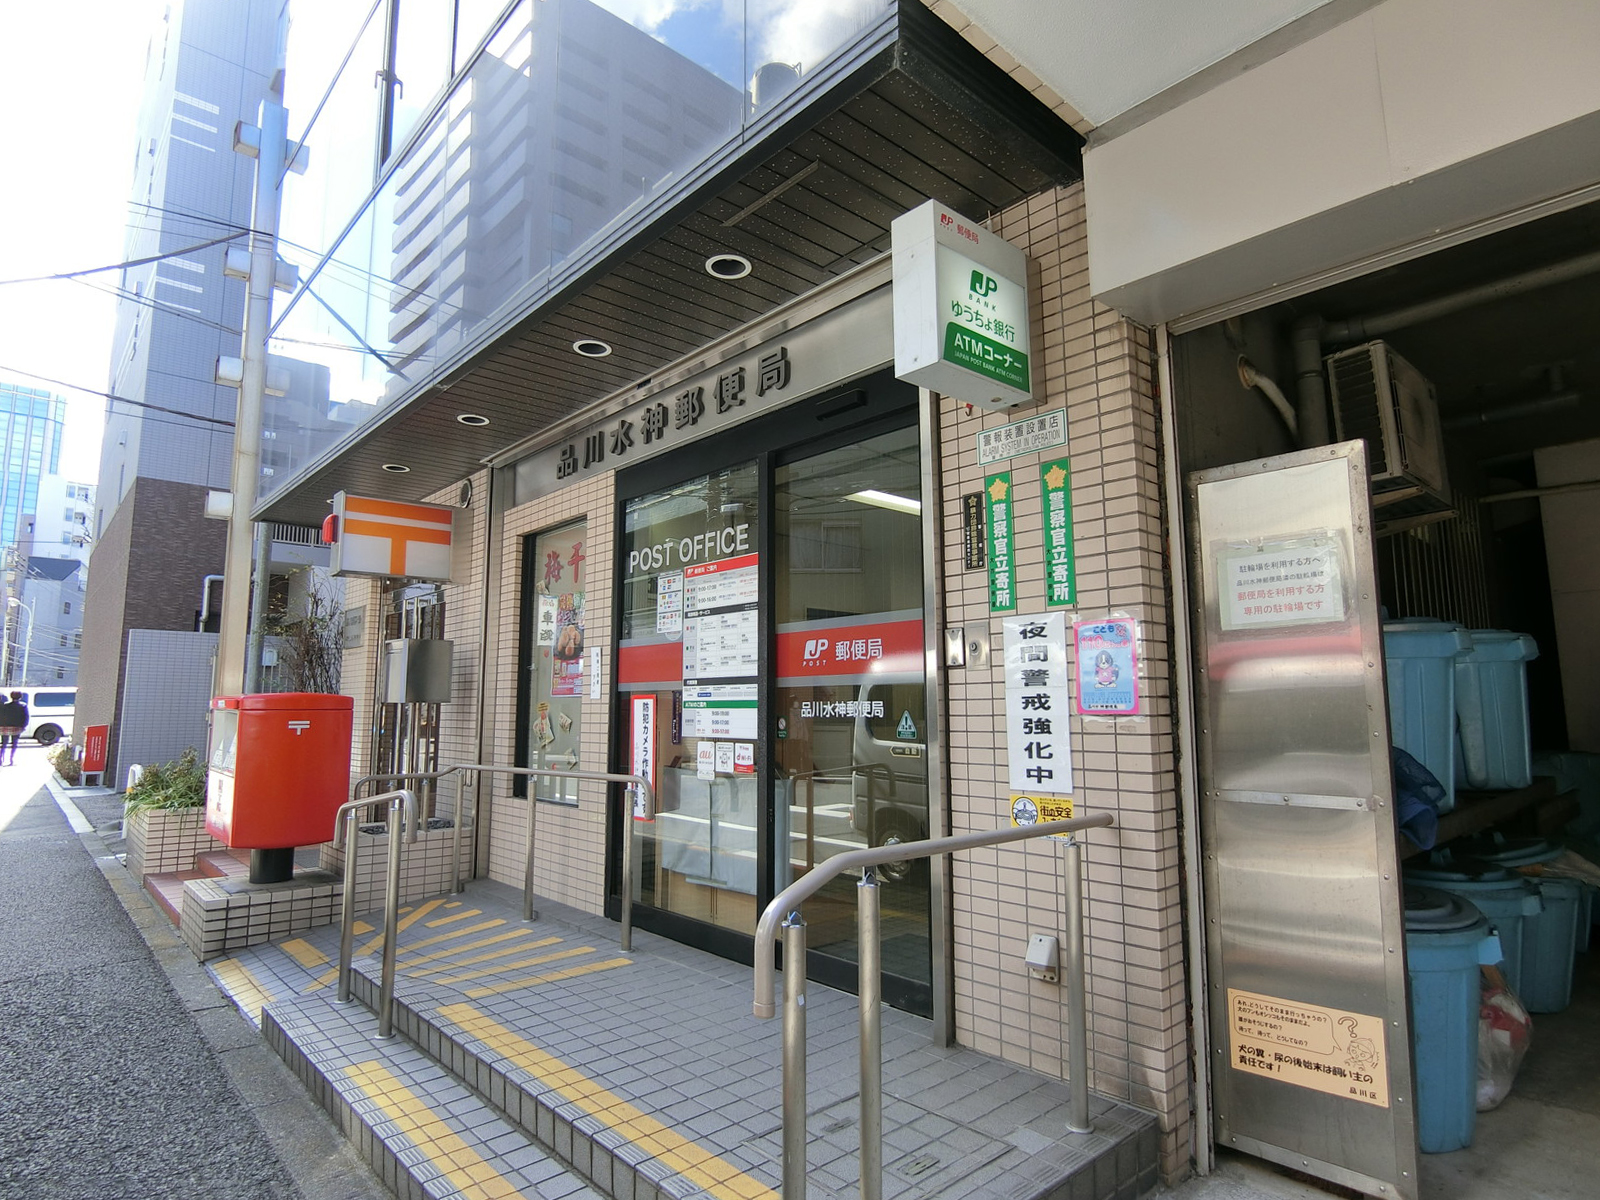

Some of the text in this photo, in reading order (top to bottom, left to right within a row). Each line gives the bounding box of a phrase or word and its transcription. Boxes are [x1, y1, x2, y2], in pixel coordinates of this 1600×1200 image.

[957, 224, 979, 244] 郵便局
[968, 294, 997, 312] BANK
[952, 300, 1015, 343] ゆうちょ銀行
[954, 333, 1022, 369] ATMコーナー
[954, 351, 1022, 383] JAPAN POST BANK ATM CORNER
[556, 346, 790, 480] 品川水神郵便局
[982, 444, 1000, 458] ALARM
[1001, 438, 1022, 453] SYSTEM
[1024, 436, 1030, 446] IN
[1032, 428, 1060, 444] OPERATION
[984, 416, 1058, 446] 警報装置設置店
[630, 524, 749, 573] POST OFFICE
[992, 503, 1010, 607] 警察官立寄所
[1049, 492, 1069, 600] 警察官立寄所
[1239, 557, 1321, 573] 駐輪場を利用する方へ
[1238, 584, 1325, 601] 郵便局を利用する方
[1244, 600, 1324, 616] 専用の駐輪場です
[1093, 624, 1114, 634] こども
[835, 638, 883, 661] 郵便局
[801, 701, 884, 718] 品川水神郵便局
[1018, 622, 1053, 784] 夜間警戒強化中
[1040, 805, 1072, 818] 街の安全
[1350, 1087, 1377, 1100] 品川区
